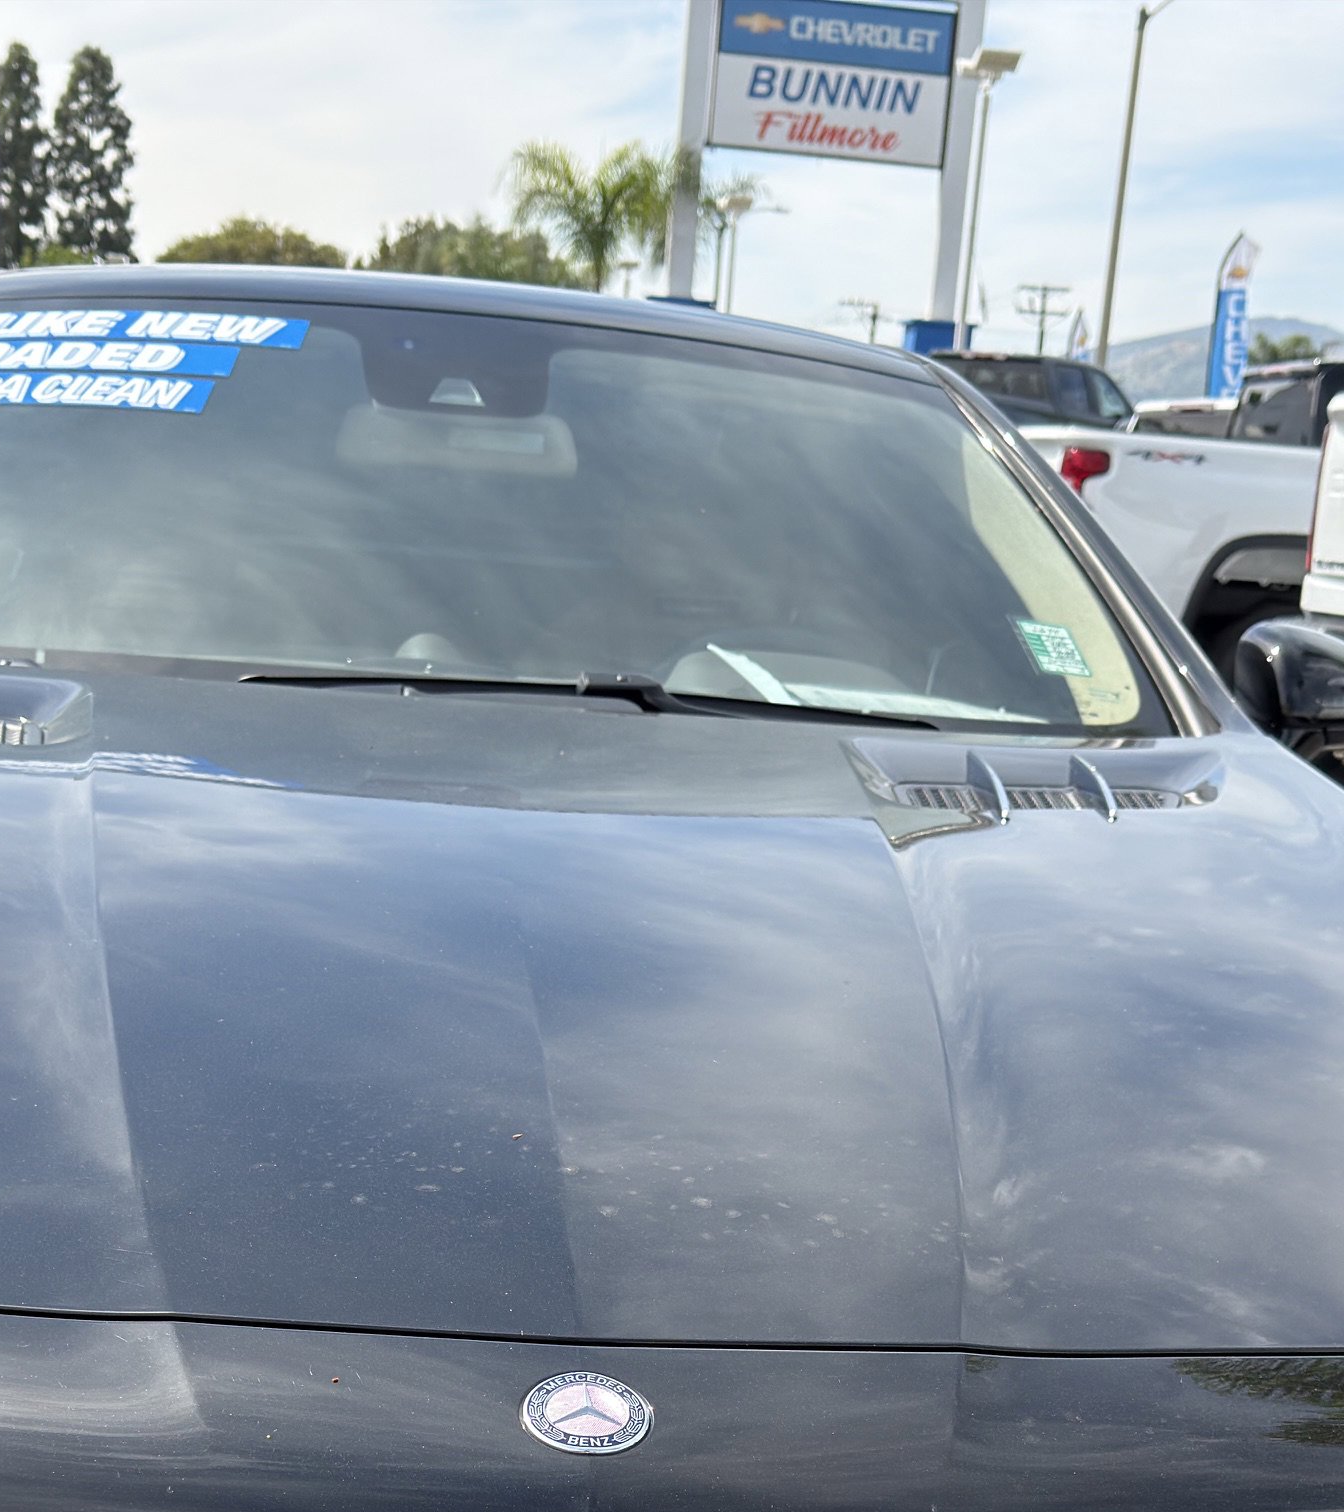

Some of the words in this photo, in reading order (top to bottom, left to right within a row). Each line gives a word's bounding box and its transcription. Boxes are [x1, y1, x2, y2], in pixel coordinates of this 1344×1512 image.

[789, 15, 941, 54] CHEVROLET
[747, 63, 923, 115] BUNNIN
[754, 109, 901, 151] Fillmore
[124, 311, 289, 344] NEW
[31, 373, 194, 410] CLEAN
[543, 1373, 626, 1394] MERCEDES
[567, 1436, 614, 1447] BENZ
